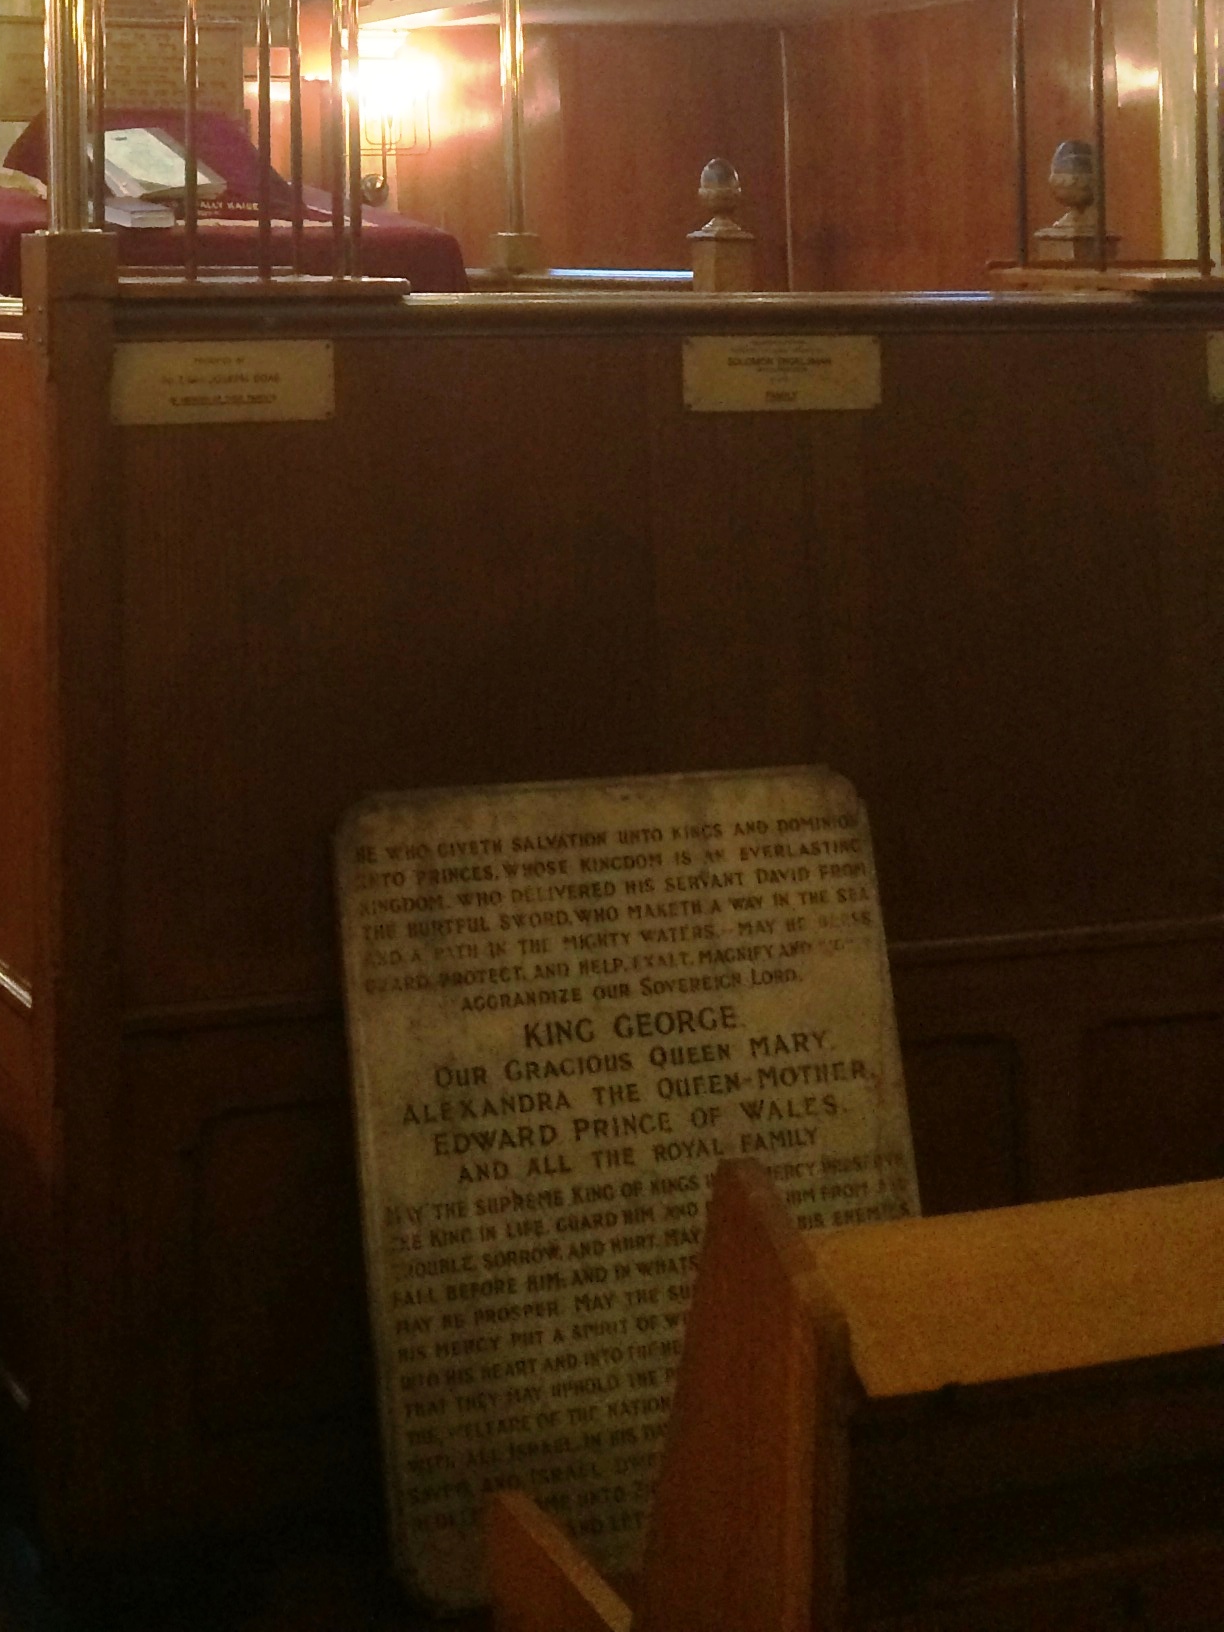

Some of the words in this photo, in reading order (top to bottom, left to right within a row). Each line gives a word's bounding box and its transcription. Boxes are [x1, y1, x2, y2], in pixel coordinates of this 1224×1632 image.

[384, 843, 430, 861] WHO
[436, 838, 503, 857] GIVETH
[511, 831, 608, 852] SALVATION
[617, 827, 663, 845] UNTO
[670, 823, 722, 840] KINGS
[733, 819, 769, 835] AND
[501, 859, 568, 878] WHOSE
[579, 853, 662, 873] KINGDOM
[674, 850, 692, 865] IS
[739, 839, 859, 860] EVERLASTING
[457, 890, 502, 907] WHO
[510, 881, 615, 903] DELIVERED
[624, 877, 654, 893] HIS
[664, 871, 744, 891] SERVANT
[755, 865, 810, 883] DAVID
[819, 861, 865, 879] FROM
[361, 922, 397, 941] THE
[407, 916, 488, 937] HURTFUL
[573, 905, 618, 923] WHO
[626, 900, 701, 919] MAKETH
[710, 898, 721, 913] A
[730, 895, 763, 910] WAY
[772, 892, 789, 907] IN
[798, 890, 827, 905] THE
[836, 886, 869, 902] SEA
[409, 948, 421, 962] A
[487, 940, 507, 958] IN
[517, 937, 549, 954] THE
[562, 931, 630, 951] MIGHTY
[737, 920, 776, 937] MAY
[784, 916, 806, 933] HE
[532, 961, 571, 979] AND
[698, 943, 774, 964] MAGNIFY
[778, 939, 812, 957] AND
[460, 986, 582, 1012] AGGRANDIZE
[591, 982, 631, 1000] OUR
[638, 969, 742, 996] SOVEREIGN
[523, 1017, 595, 1048] KING
[434, 1061, 487, 1088] OUR
[503, 1048, 633, 1081] GRACIOUS
[648, 1038, 731, 1069] QUEEN
[401, 1089, 571, 1125] ALEXANDRA
[591, 1082, 639, 1107] THE
[433, 1122, 558, 1156] EDWARD
[572, 1110, 672, 1141] PRINCE
[689, 1104, 721, 1128] OF
[456, 1160, 509, 1183] AND
[526, 1154, 571, 1177] ALL
[591, 1146, 635, 1169] THE
[652, 1137, 724, 1162] ROYAL
[739, 1126, 818, 1153] FAMILY
[429, 1226, 472, 1247] KING
[479, 1224, 496, 1241] IN
[554, 1210, 618, 1232] GUARD
[621, 1206, 654, 1224] HIM
[665, 1200, 699, 1219] AND
[820, 1180, 868, 1201] FROM
[433, 1200, 468, 1220] THE
[472, 1184, 564, 1216] SUPREME
[571, 1183, 614, 1205] KING
[619, 1180, 644, 1198] OF
[648, 1174, 700, 1195] KINGS
[567, 1239, 605, 1258] AND
[664, 1225, 702, 1247] MAY
[796, 1211, 824, 1230] HIS
[392, 1287, 436, 1307] FALL
[446, 1277, 517, 1300] BEFORE
[570, 1266, 608, 1285] AND
[614, 1264, 631, 1279] IN
[574, 1290, 615, 1312] MAY
[624, 1286, 659, 1306] THE
[434, 1334, 501, 1358] MERCY
[510, 1328, 544, 1347] PUT
[552, 1326, 563, 1341] A
[635, 1314, 658, 1332] OF
[444, 1366, 473, 1385] HIS
[480, 1358, 538, 1380] HEART
[542, 1352, 578, 1372] AND
[456, 1390, 496, 1412] THEY
[550, 1374, 620, 1398] UPHOLD
[625, 1369, 657, 1388] THE
[607, 1395, 672, 1418] NATION
